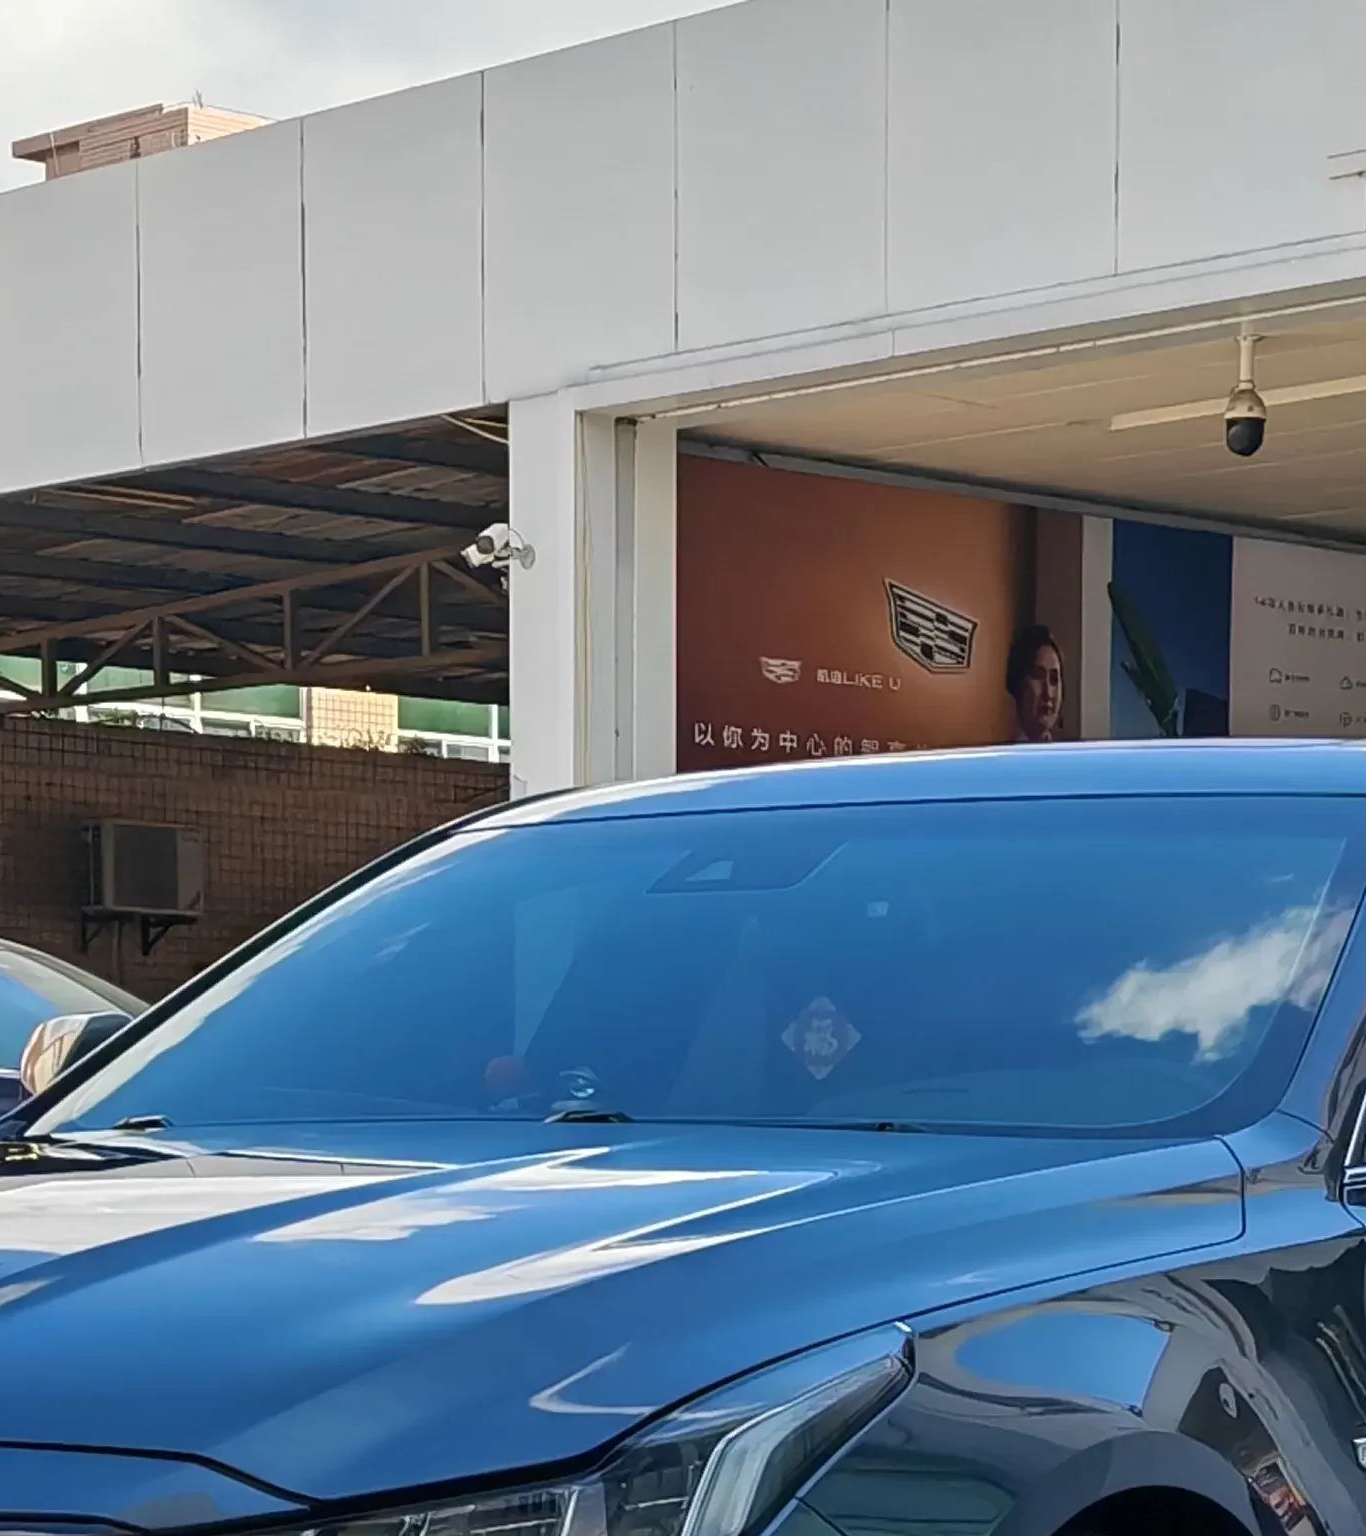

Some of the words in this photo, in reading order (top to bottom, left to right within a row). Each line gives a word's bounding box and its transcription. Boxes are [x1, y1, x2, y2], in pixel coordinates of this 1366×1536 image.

[693, 721, 925, 757] 以你为中心的
